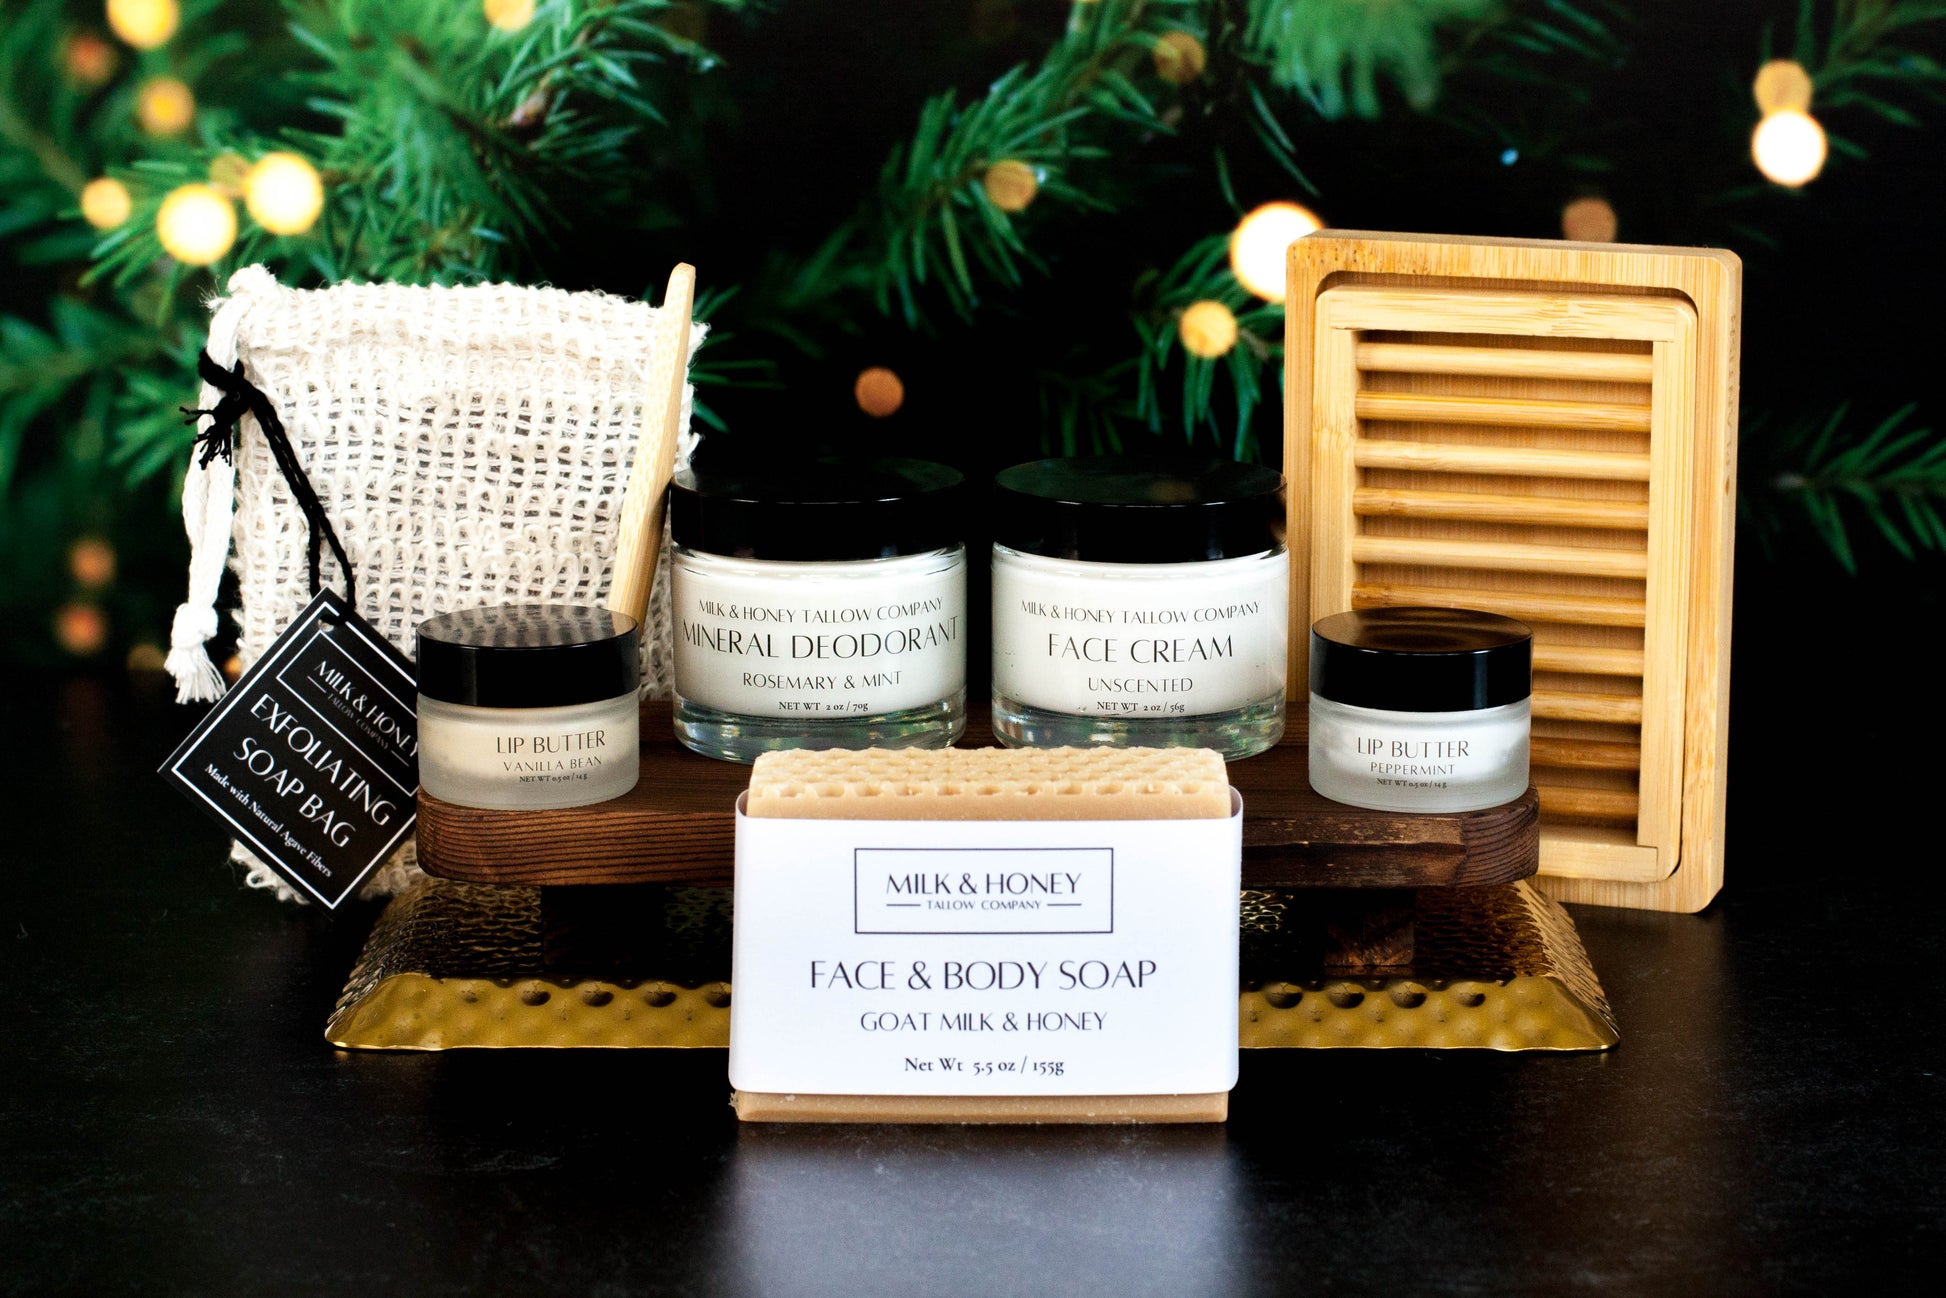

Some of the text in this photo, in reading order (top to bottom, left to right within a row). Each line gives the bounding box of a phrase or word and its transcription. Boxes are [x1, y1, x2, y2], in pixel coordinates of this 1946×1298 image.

[700, 597, 943, 624] MILK & HONEY TALLOW COMPANY
[1022, 600, 1260, 624] MILK & HONEY TALLOW COMPANY
[682, 616, 959, 659] MINERAL DEODORANT
[1049, 633, 1232, 663] FACE CREAM
[314, 660, 357, 701] MILK
[352, 696, 366, 712] &
[743, 670, 902, 690] ROSEMARY & MINT
[1088, 678, 1192, 693] UNSCENTED
[779, 701, 800, 710] NET
[803, 702, 820, 710] WT
[846, 701, 850, 712] /
[852, 703, 868, 712] 70g
[1098, 701, 1118, 711] NET
[1120, 702, 1138, 711] WT
[1163, 702, 1168, 712] /
[1170, 703, 1184, 712] 56g
[327, 693, 389, 750] TALLOW COMPANY
[497, 730, 606, 753] LIP BUTTER
[1358, 737, 1469, 758] LIP BUTTER
[250, 694, 397, 826] EXFOLIATING
[503, 756, 602, 772] VANILLA BEAN
[1370, 762, 1455, 775] PEPPERMINT
[233, 737, 356, 848] SOAP BAG
[204, 763, 332, 877] Made with Natural Agave Fibers
[886, 873, 1082, 894] MILK & HONEY
[927, 900, 1042, 910] TALLOW COMPANY
[810, 961, 1157, 990] FACE & BODY SOAP
[860, 1012, 1108, 1032] GOAT MILK & HONEY
[904, 1057, 1065, 1075] Net Wt 5.5 oz / 155g
